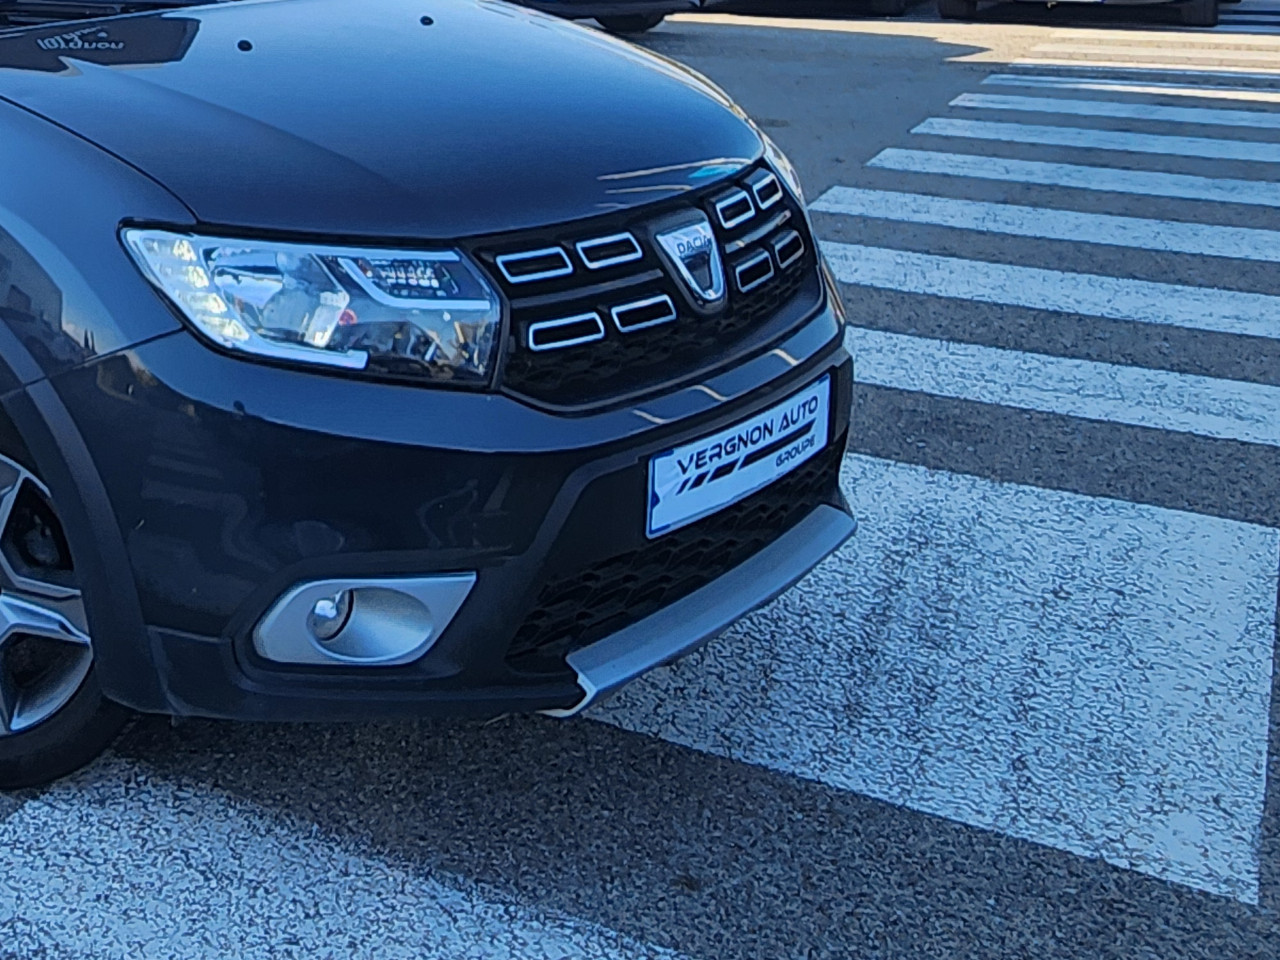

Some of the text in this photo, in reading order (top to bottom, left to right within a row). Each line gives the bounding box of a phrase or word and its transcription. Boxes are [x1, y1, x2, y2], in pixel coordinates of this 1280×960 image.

[676, 235, 713, 254] DACIA
[676, 394, 819, 476] VERGNON AUTO
[775, 433, 817, 468] GROUPE
